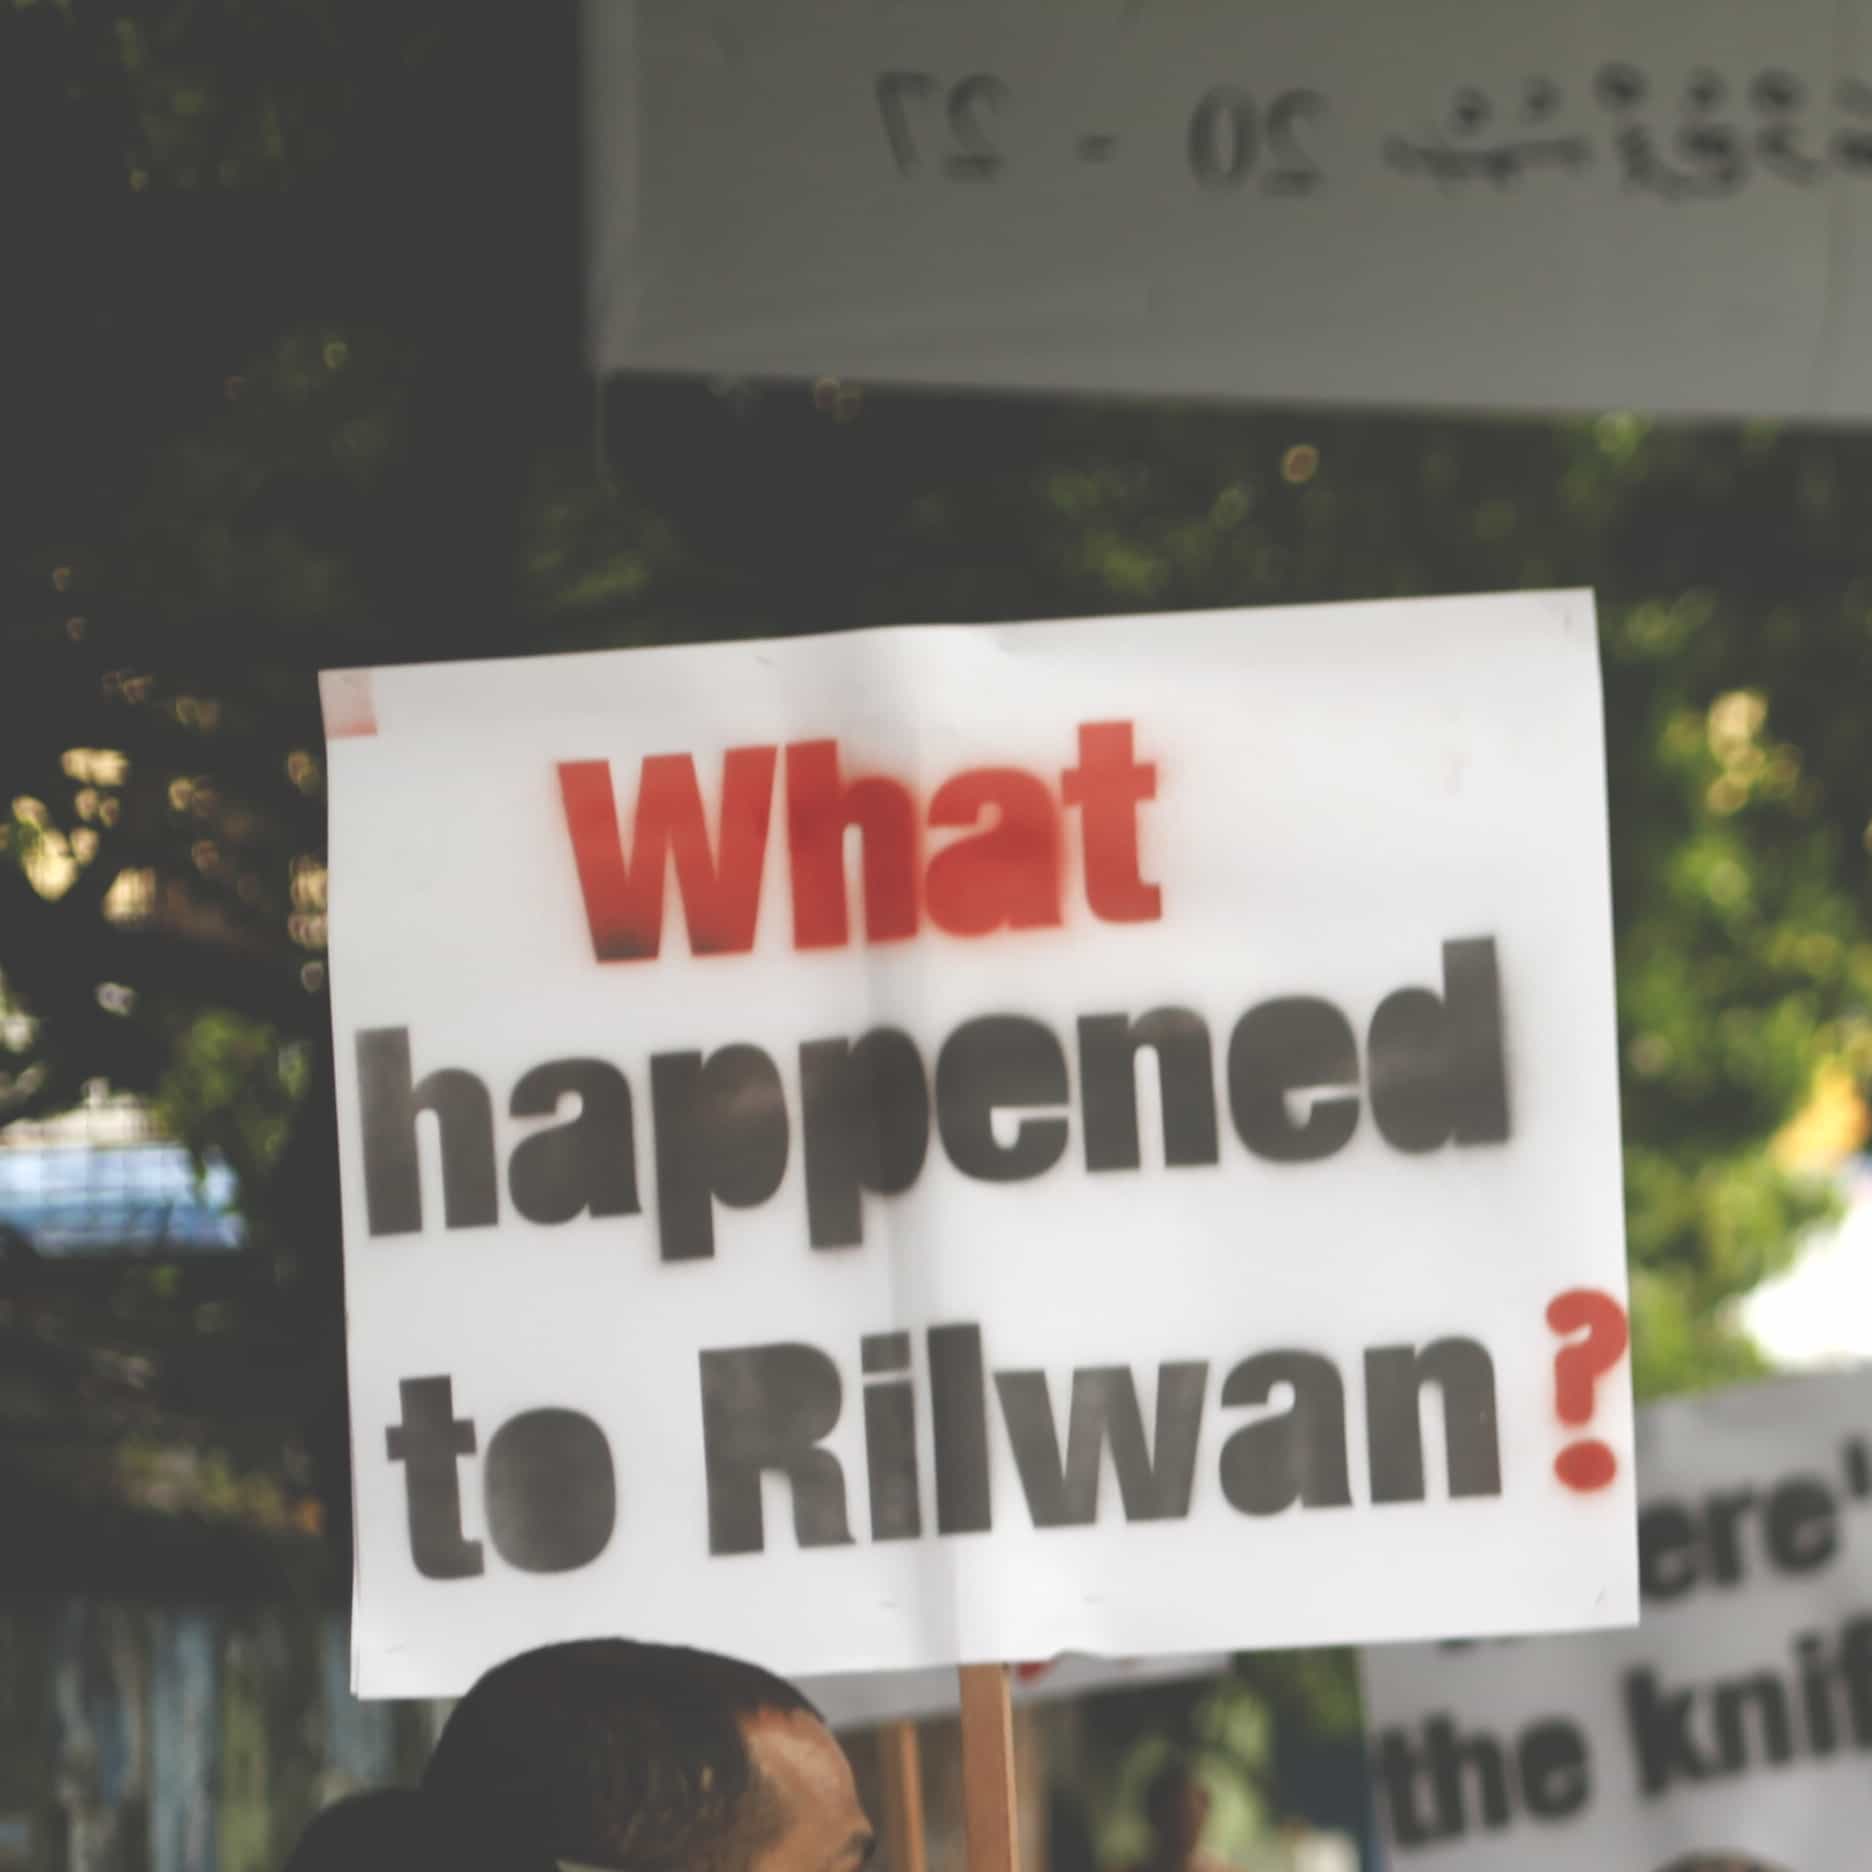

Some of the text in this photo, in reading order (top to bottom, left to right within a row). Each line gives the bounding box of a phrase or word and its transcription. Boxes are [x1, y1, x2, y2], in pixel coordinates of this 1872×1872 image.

[557, 720, 1162, 963] What
[355, 935, 1513, 1261] happened
[387, 1375, 617, 1580] to
[1370, 1708, 1590, 1850] the
